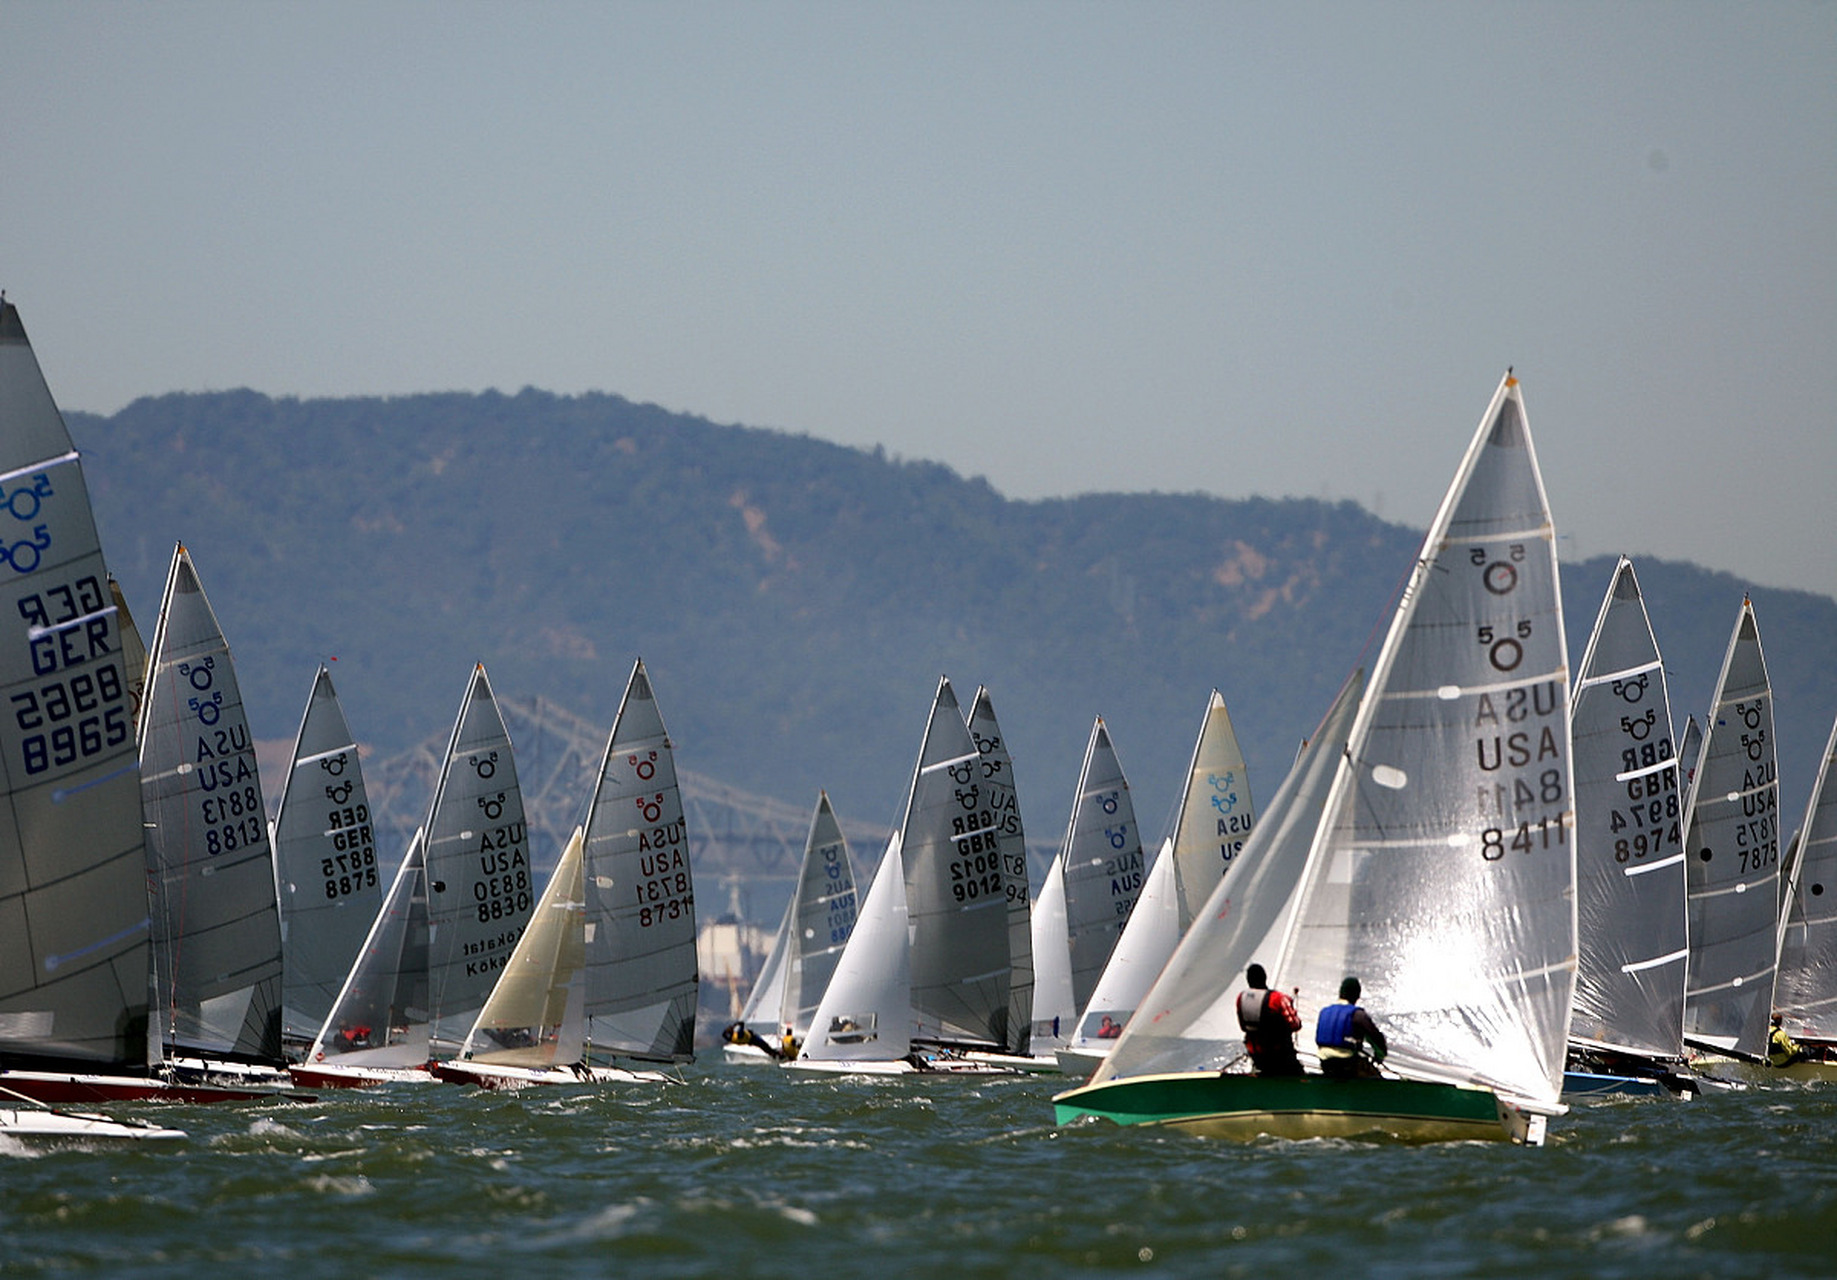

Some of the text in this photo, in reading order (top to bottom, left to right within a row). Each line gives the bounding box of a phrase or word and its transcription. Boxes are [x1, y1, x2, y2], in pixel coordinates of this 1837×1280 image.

[29, 616, 109, 676] GER
[22, 706, 126, 776] 8965
[1477, 726, 1559, 772] USA
[198, 756, 251, 792] USA
[1628, 766, 1677, 800] GBR
[1743, 786, 1776, 817] USA
[206, 817, 260, 855] 8813
[333, 825, 372, 851] GER
[958, 831, 997, 857] GBR
[1221, 841, 1243, 861] US
[1482, 812, 1565, 862] 8411
[1615, 821, 1681, 863] 8974
[481, 848, 525, 876] USA
[641, 849, 683, 877] USA
[1738, 840, 1778, 874] 7875
[325, 868, 376, 899] 8875
[953, 872, 1001, 902] 9012
[1005, 884, 1027, 904] 94
[1112, 872, 1141, 896] AUS
[478, 892, 529, 923] 8830
[639, 895, 690, 928] 8731
